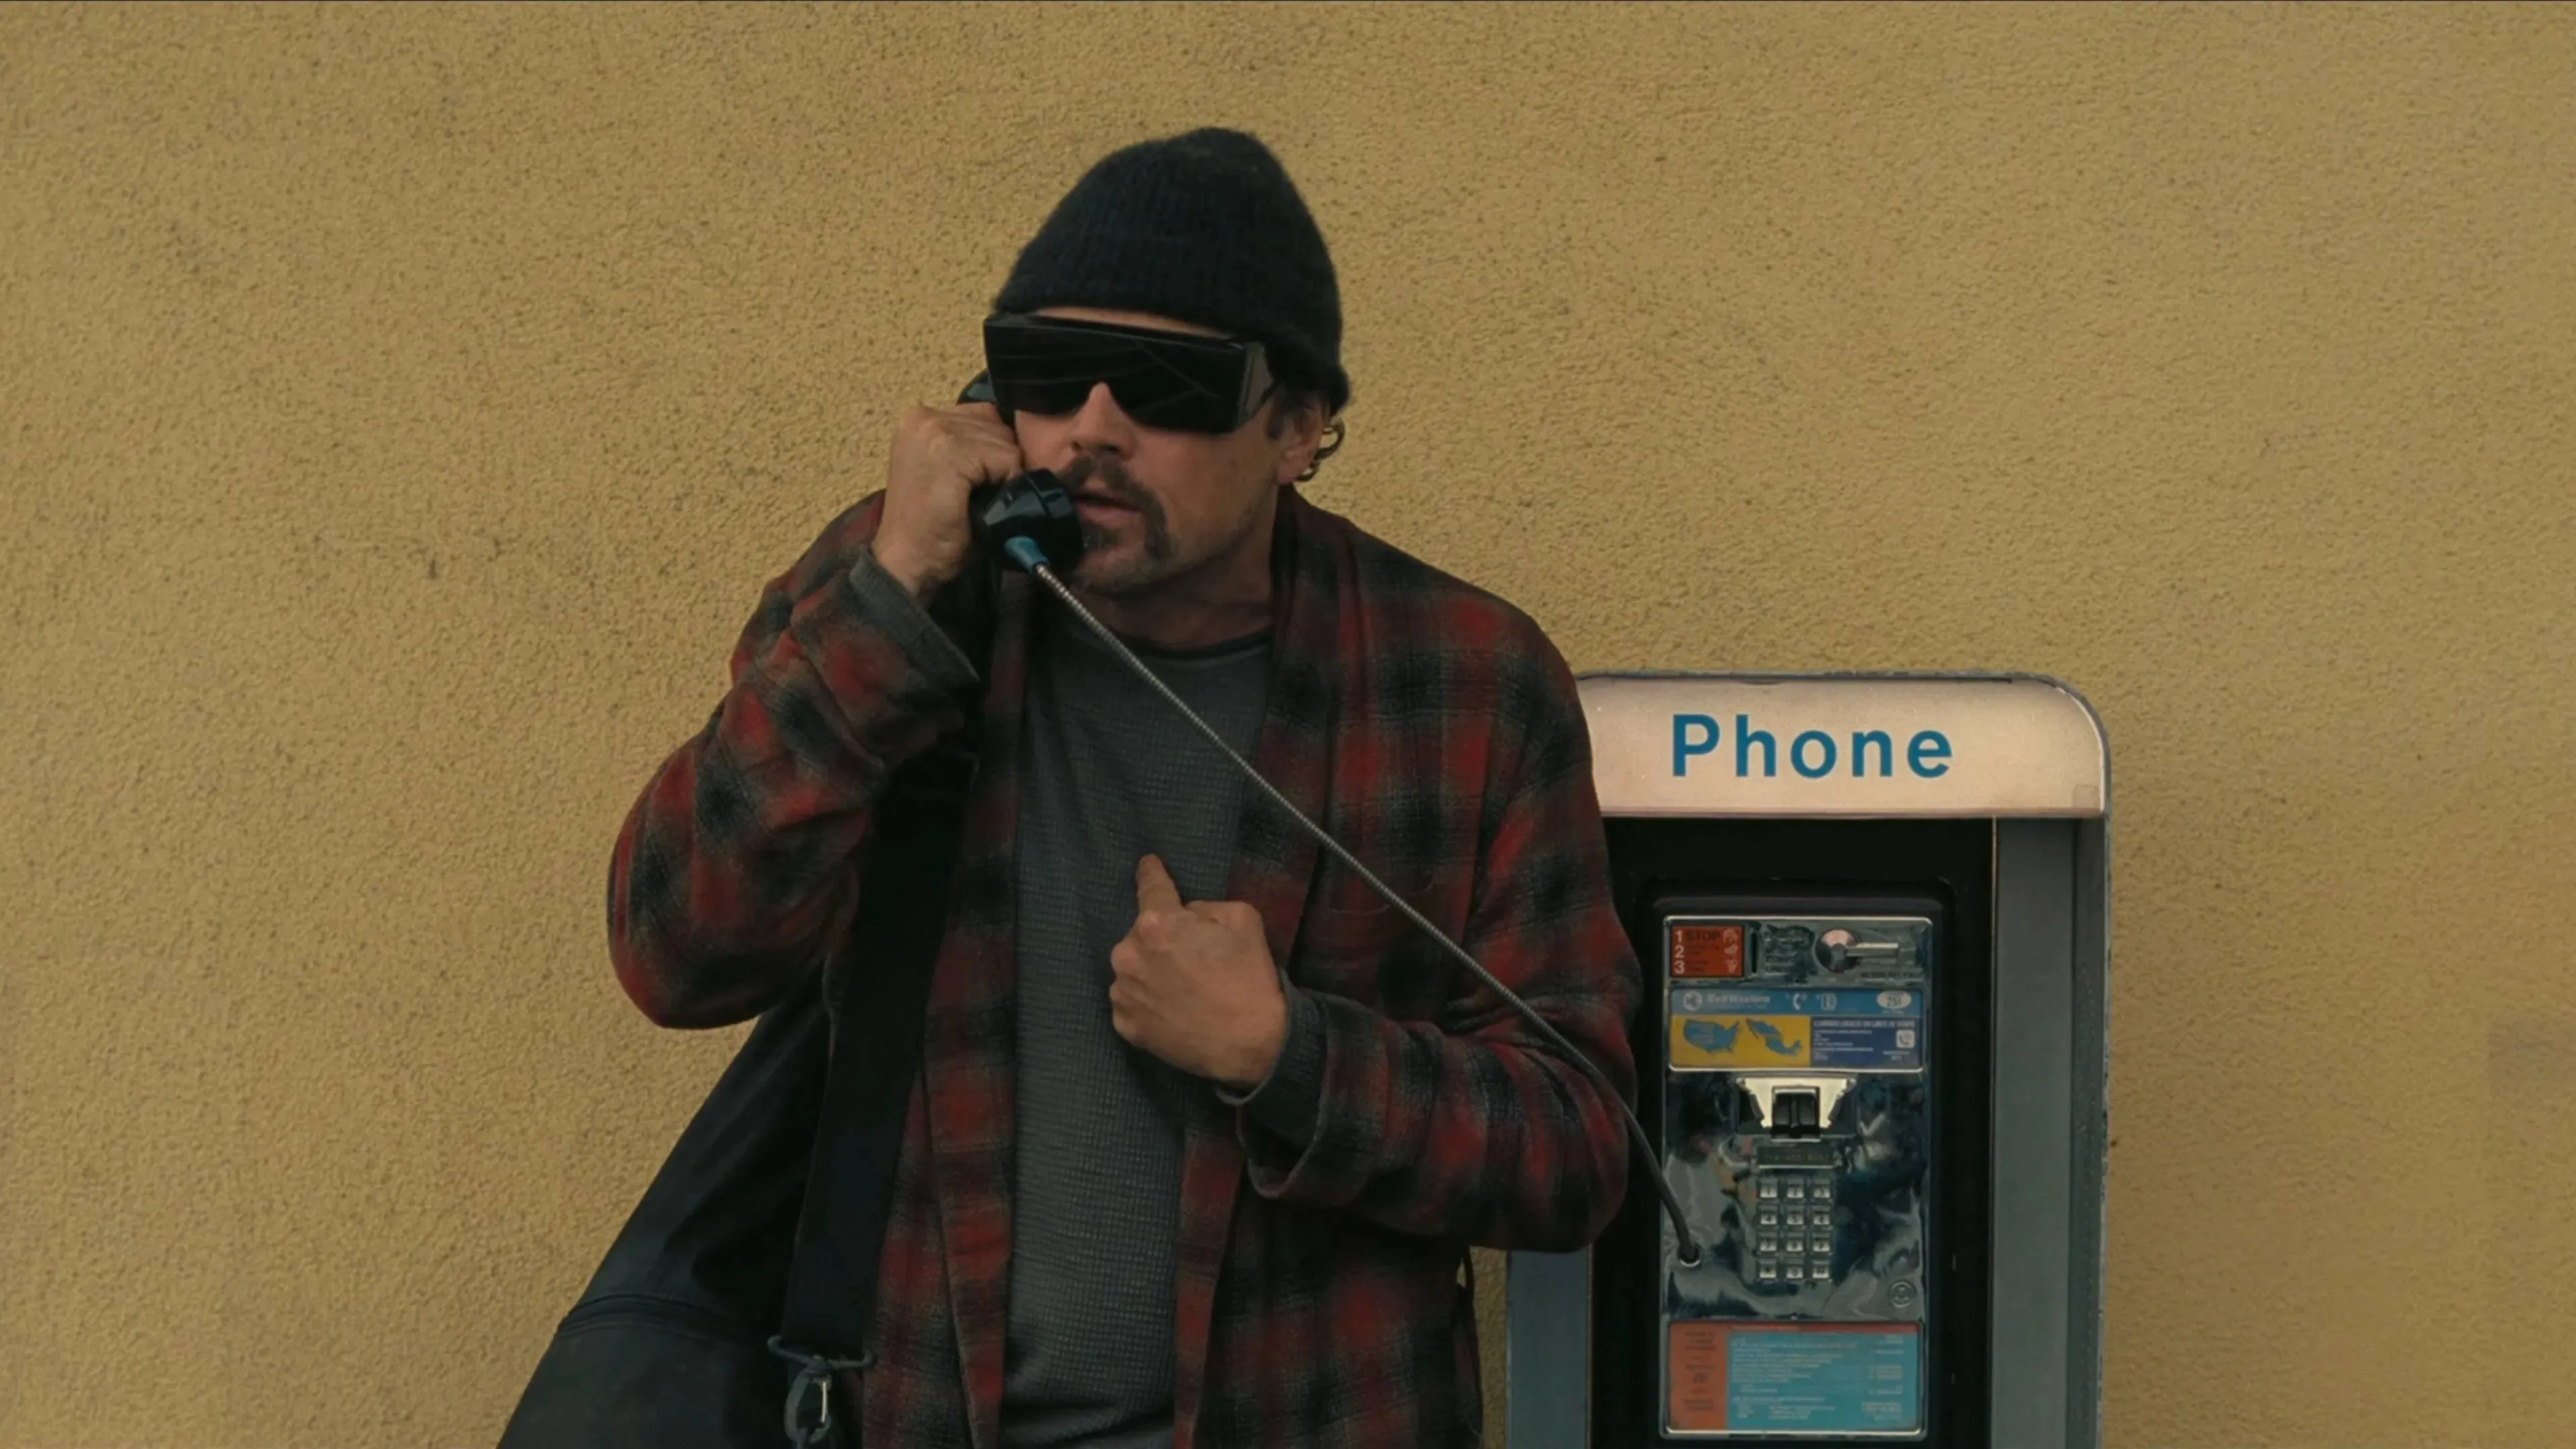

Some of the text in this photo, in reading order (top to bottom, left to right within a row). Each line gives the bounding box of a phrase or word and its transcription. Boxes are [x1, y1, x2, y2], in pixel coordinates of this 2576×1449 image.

[1672, 713, 1952, 779] Phone
[1675, 930, 1682, 943] 1
[1675, 945, 1684, 958] 2
[1674, 960, 1684, 975] 3
